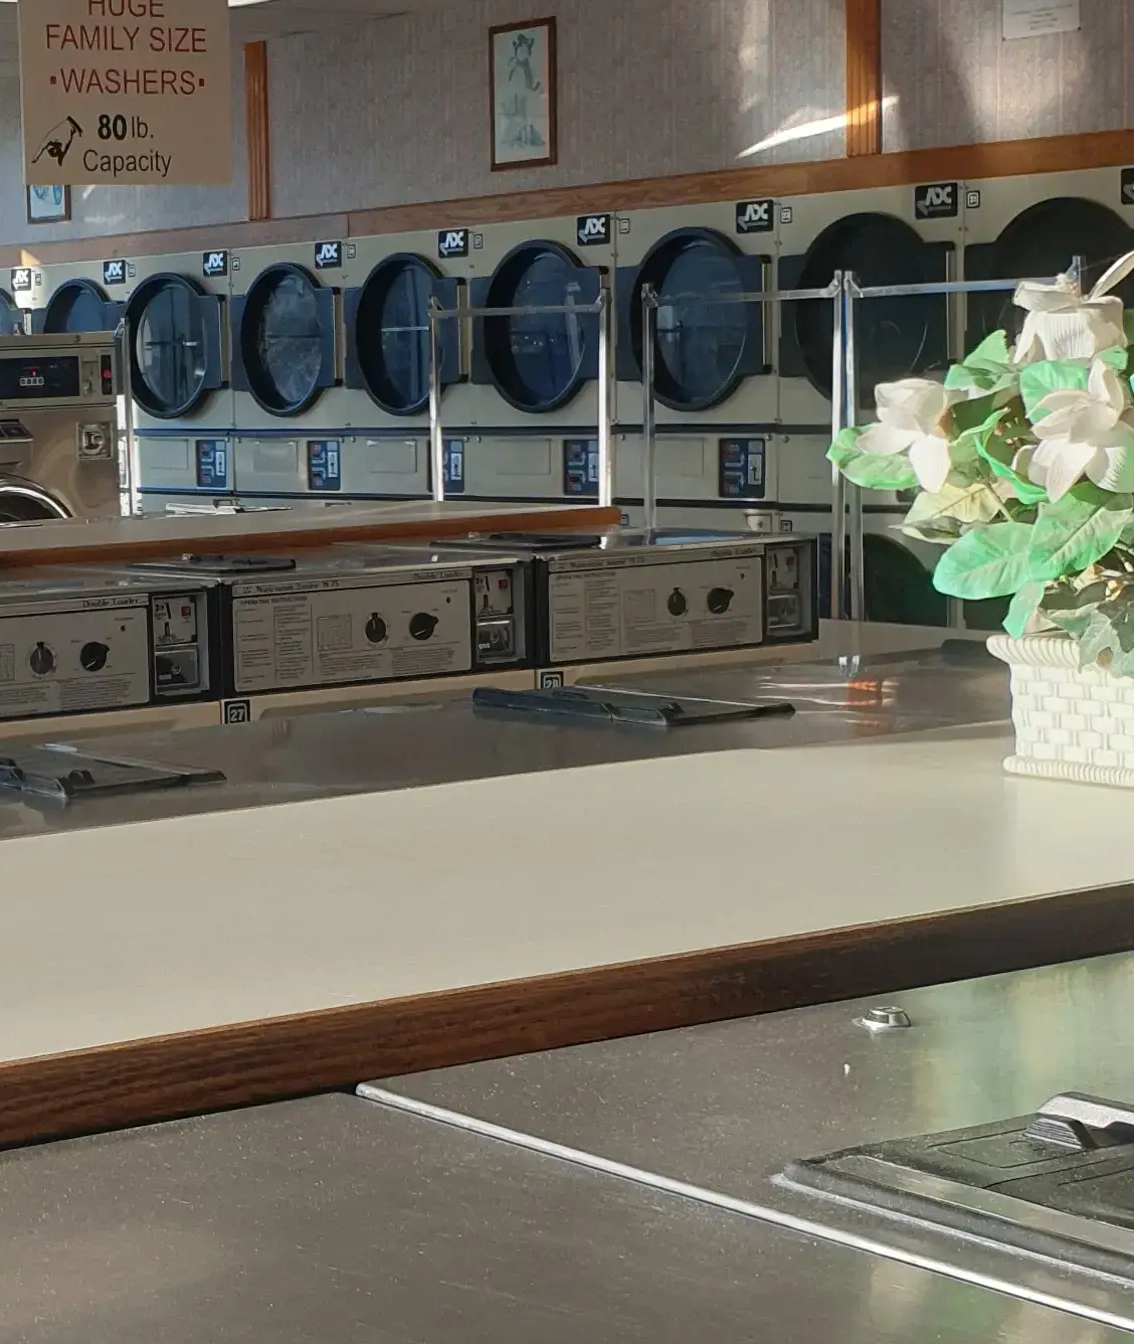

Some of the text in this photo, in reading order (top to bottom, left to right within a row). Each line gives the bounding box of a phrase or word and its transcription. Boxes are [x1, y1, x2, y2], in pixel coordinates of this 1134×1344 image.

[46, 24, 207, 52] FAMILY SIZE
[98, 114, 153, 140] 80 lb.
[83, 149, 171, 177] Capacity
[230, 709, 245, 722] 27
